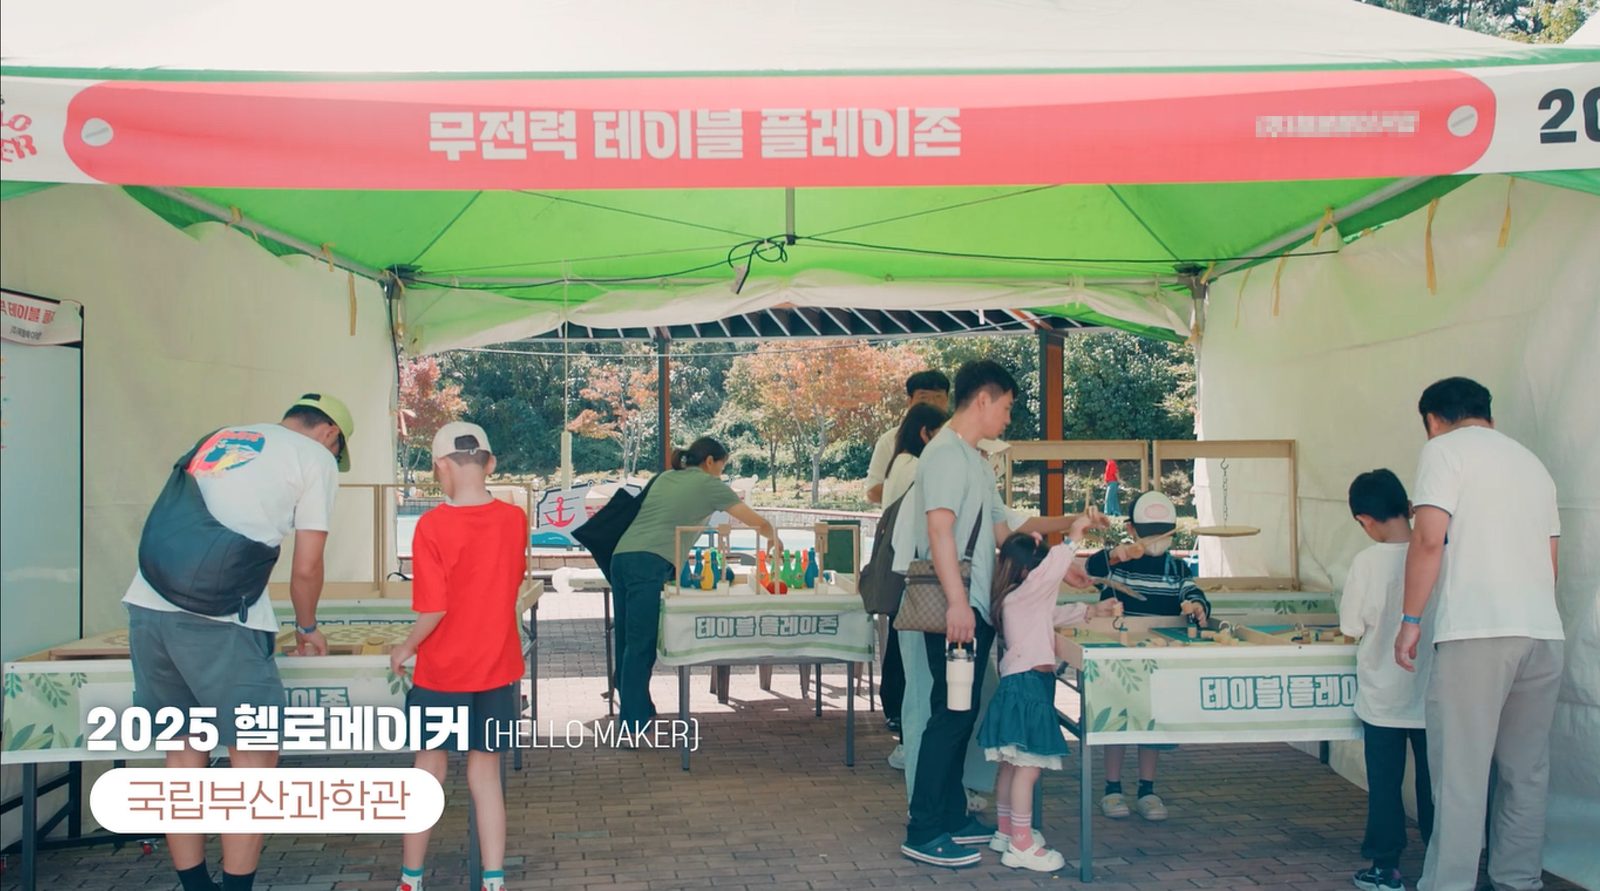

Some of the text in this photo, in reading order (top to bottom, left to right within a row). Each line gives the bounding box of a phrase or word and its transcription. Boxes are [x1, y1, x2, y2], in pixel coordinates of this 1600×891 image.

[429, 107, 961, 161] 무전력 테이블 플레이존
[695, 614, 839, 639] 테이블 플레이존
[1199, 675, 1283, 710] 테이블
